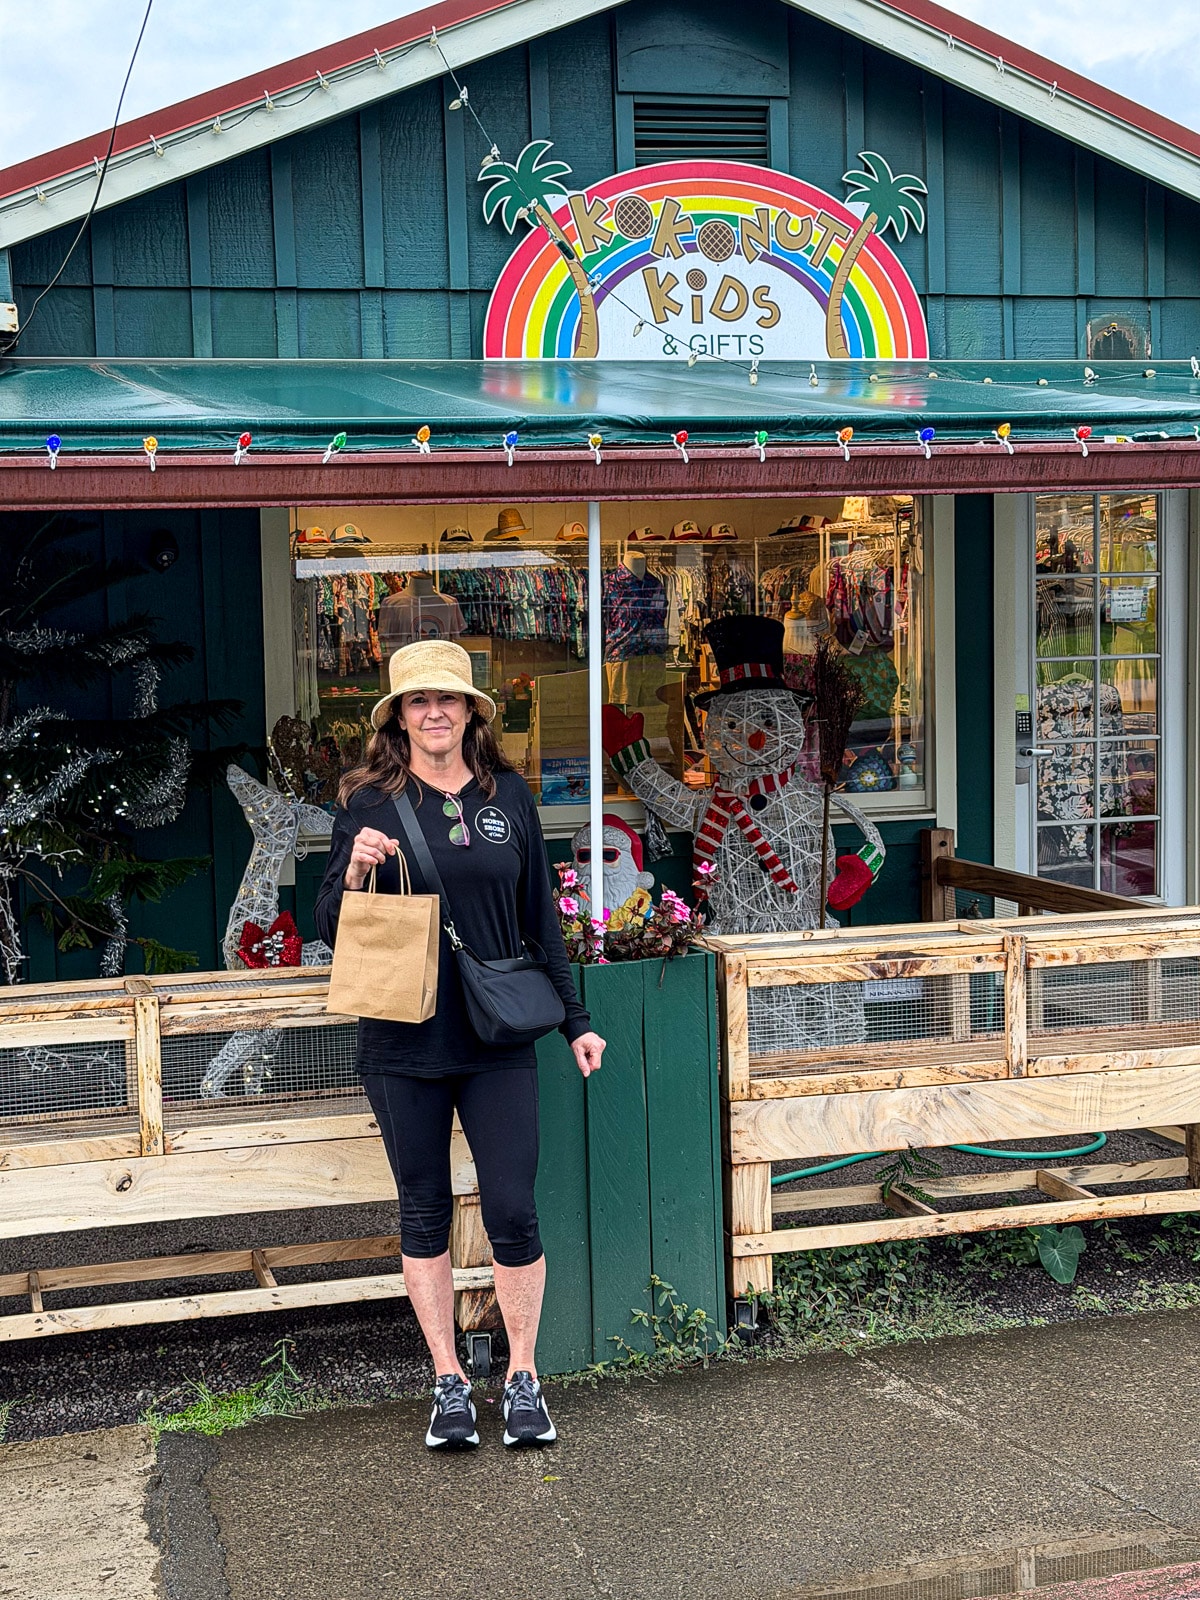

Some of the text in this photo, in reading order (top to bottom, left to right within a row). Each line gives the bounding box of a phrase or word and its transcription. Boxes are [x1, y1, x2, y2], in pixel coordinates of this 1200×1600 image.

[568, 193, 852, 269] KOKONUT
[662, 334, 764, 355] & GIFTS
[482, 818, 504, 827] NORTH
[484, 825, 505, 834] SHORE
